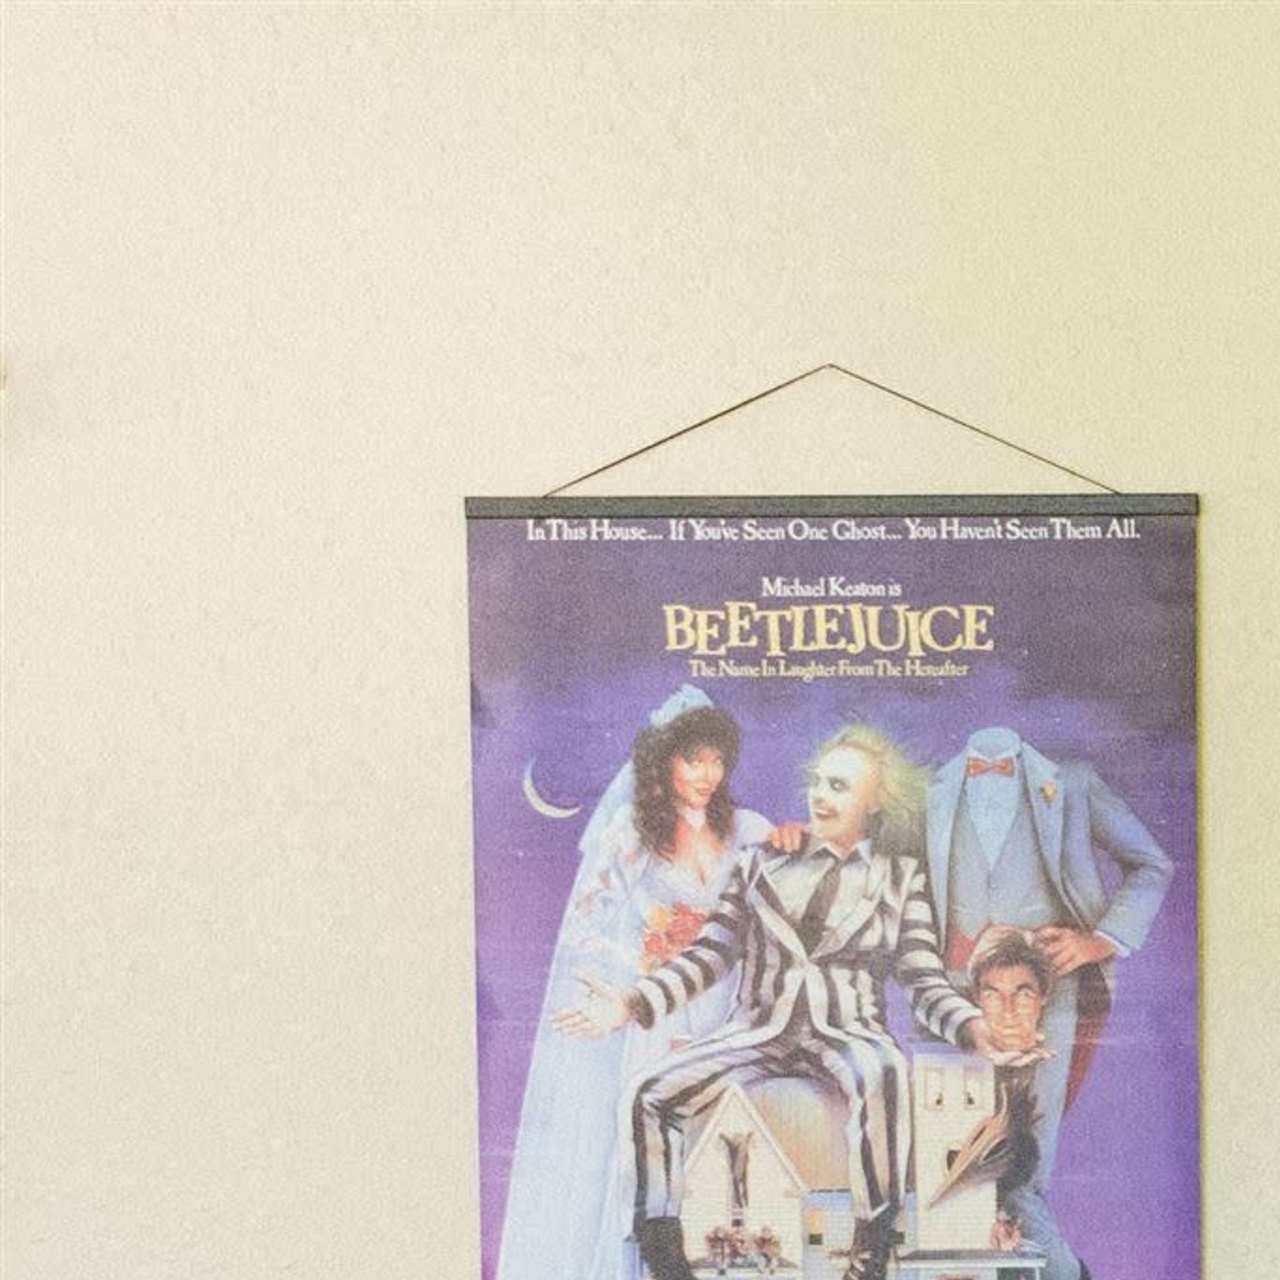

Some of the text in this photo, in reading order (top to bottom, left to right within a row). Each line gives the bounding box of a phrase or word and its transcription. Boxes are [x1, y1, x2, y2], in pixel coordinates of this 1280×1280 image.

[526, 519, 546, 540] In
[546, 519, 587, 540] This
[590, 519, 663, 541] House...
[669, 519, 686, 540] If
[742, 519, 785, 541] Seen
[787, 519, 829, 540] One
[831, 518, 900, 540] Ghost...
[904, 518, 937, 540] You
[939, 518, 1003, 540] Haven't
[1005, 518, 1048, 540] Seen
[1049, 518, 1101, 540] Them
[1105, 518, 1141, 540] All.
[762, 576, 902, 597] Michael Keaton is
[662, 600, 996, 657] BEETLEJUICE
[689, 658, 969, 682] The Name In Laughter From The Hereafter
